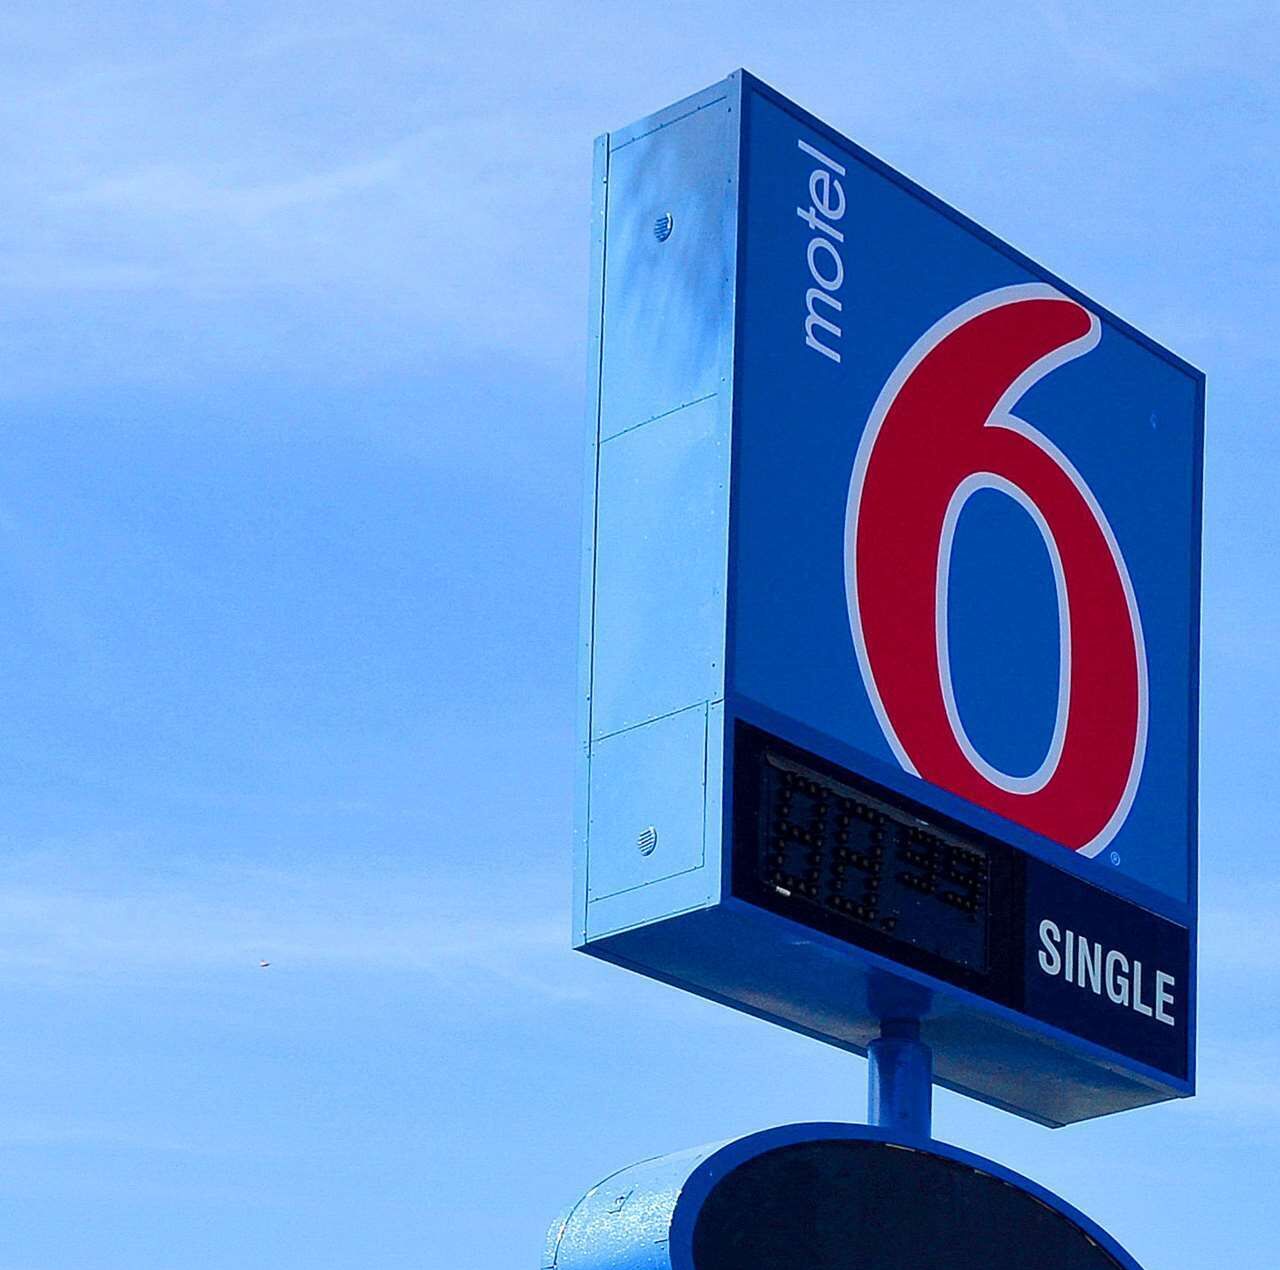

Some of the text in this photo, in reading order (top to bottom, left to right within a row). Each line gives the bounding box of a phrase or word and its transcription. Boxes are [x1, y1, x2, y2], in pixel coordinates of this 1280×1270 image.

[797, 139, 846, 363] motel
[843, 282, 1150, 859] 6
[1038, 920, 1175, 1026] SINGLE
